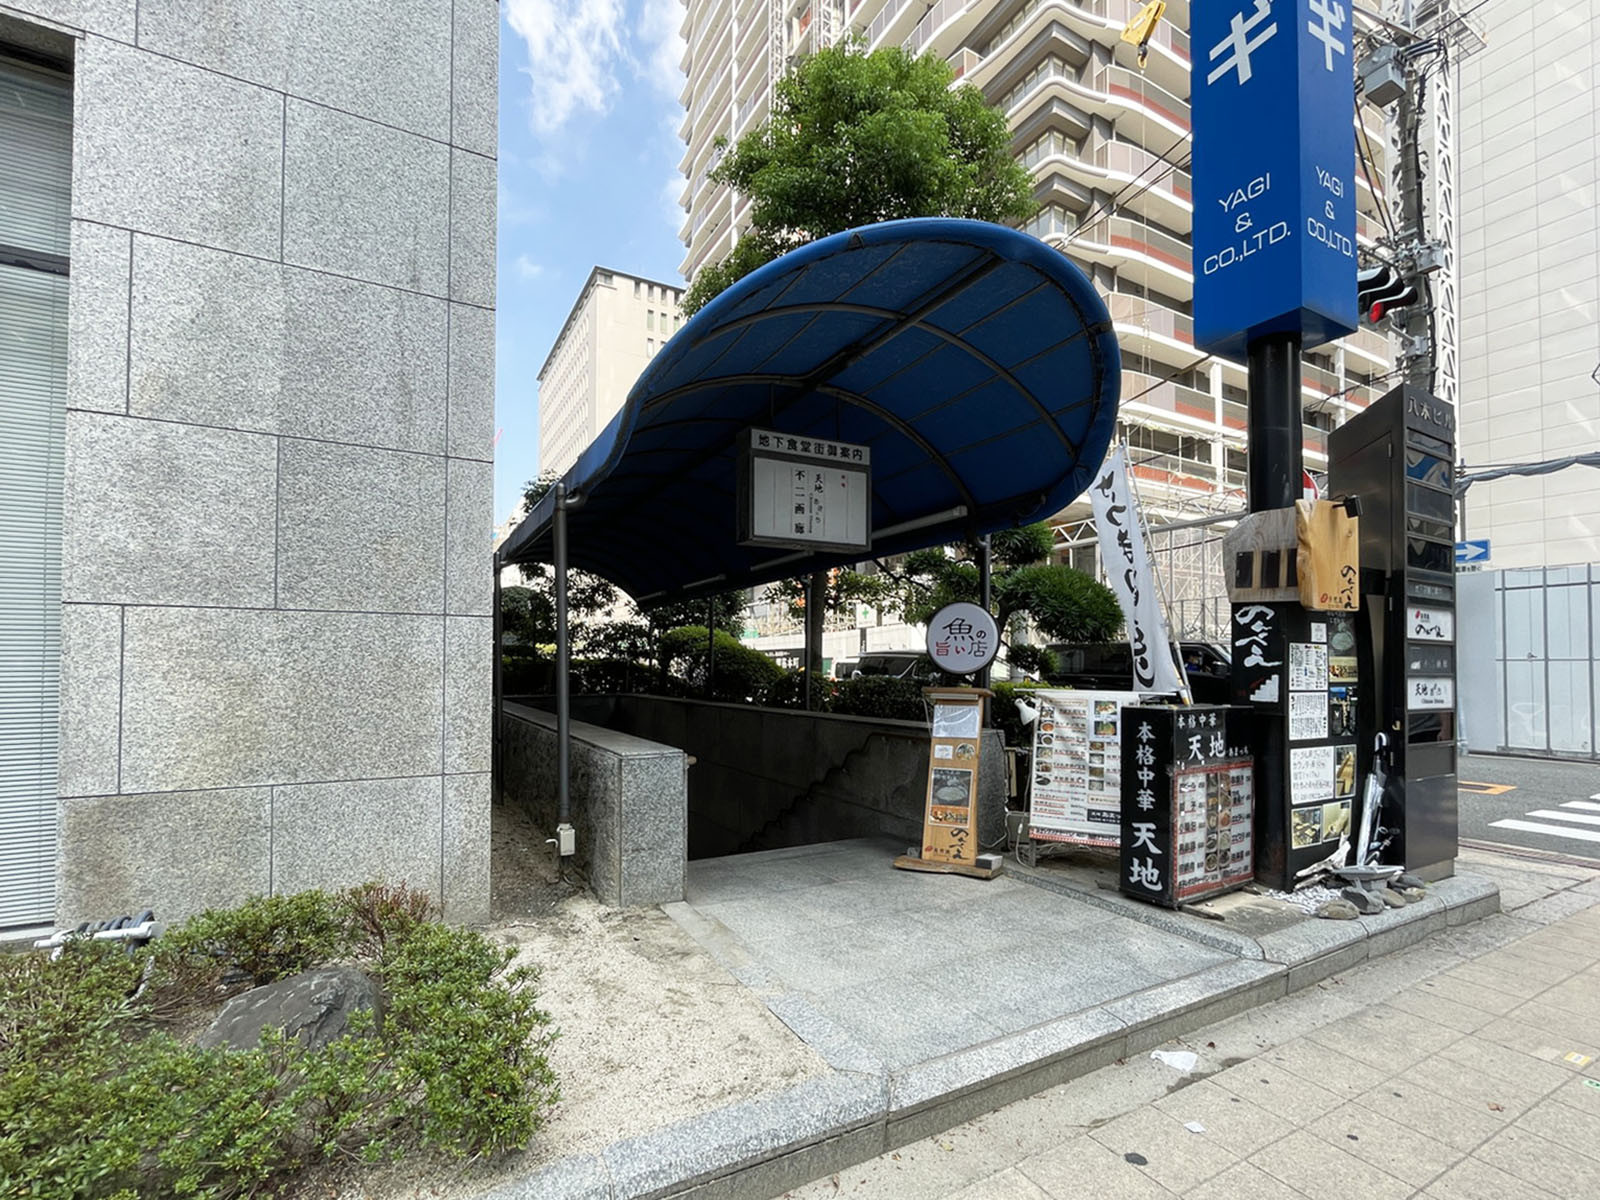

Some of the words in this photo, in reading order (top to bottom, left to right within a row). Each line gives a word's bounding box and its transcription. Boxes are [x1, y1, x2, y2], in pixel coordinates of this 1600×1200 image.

[1218, 172, 1271, 213] YAGI
[1315, 166, 1344, 199] YAGI
[1235, 213, 1253, 233] &
[1324, 200, 1336, 220] &
[1203, 221, 1292, 276] CO.,LTD.
[1408, 396, 1452, 429] 八木ビル
[758, 434, 863, 461] 地下食堂街御案内
[942, 617, 987, 642] 魚の
[935, 641, 988, 658] 旨い店
[1177, 712, 1217, 729] 本格中華
[1188, 731, 1226, 761] 天地
[1136, 721, 1157, 811] 本格中華
[1129, 822, 1163, 892] 天地
